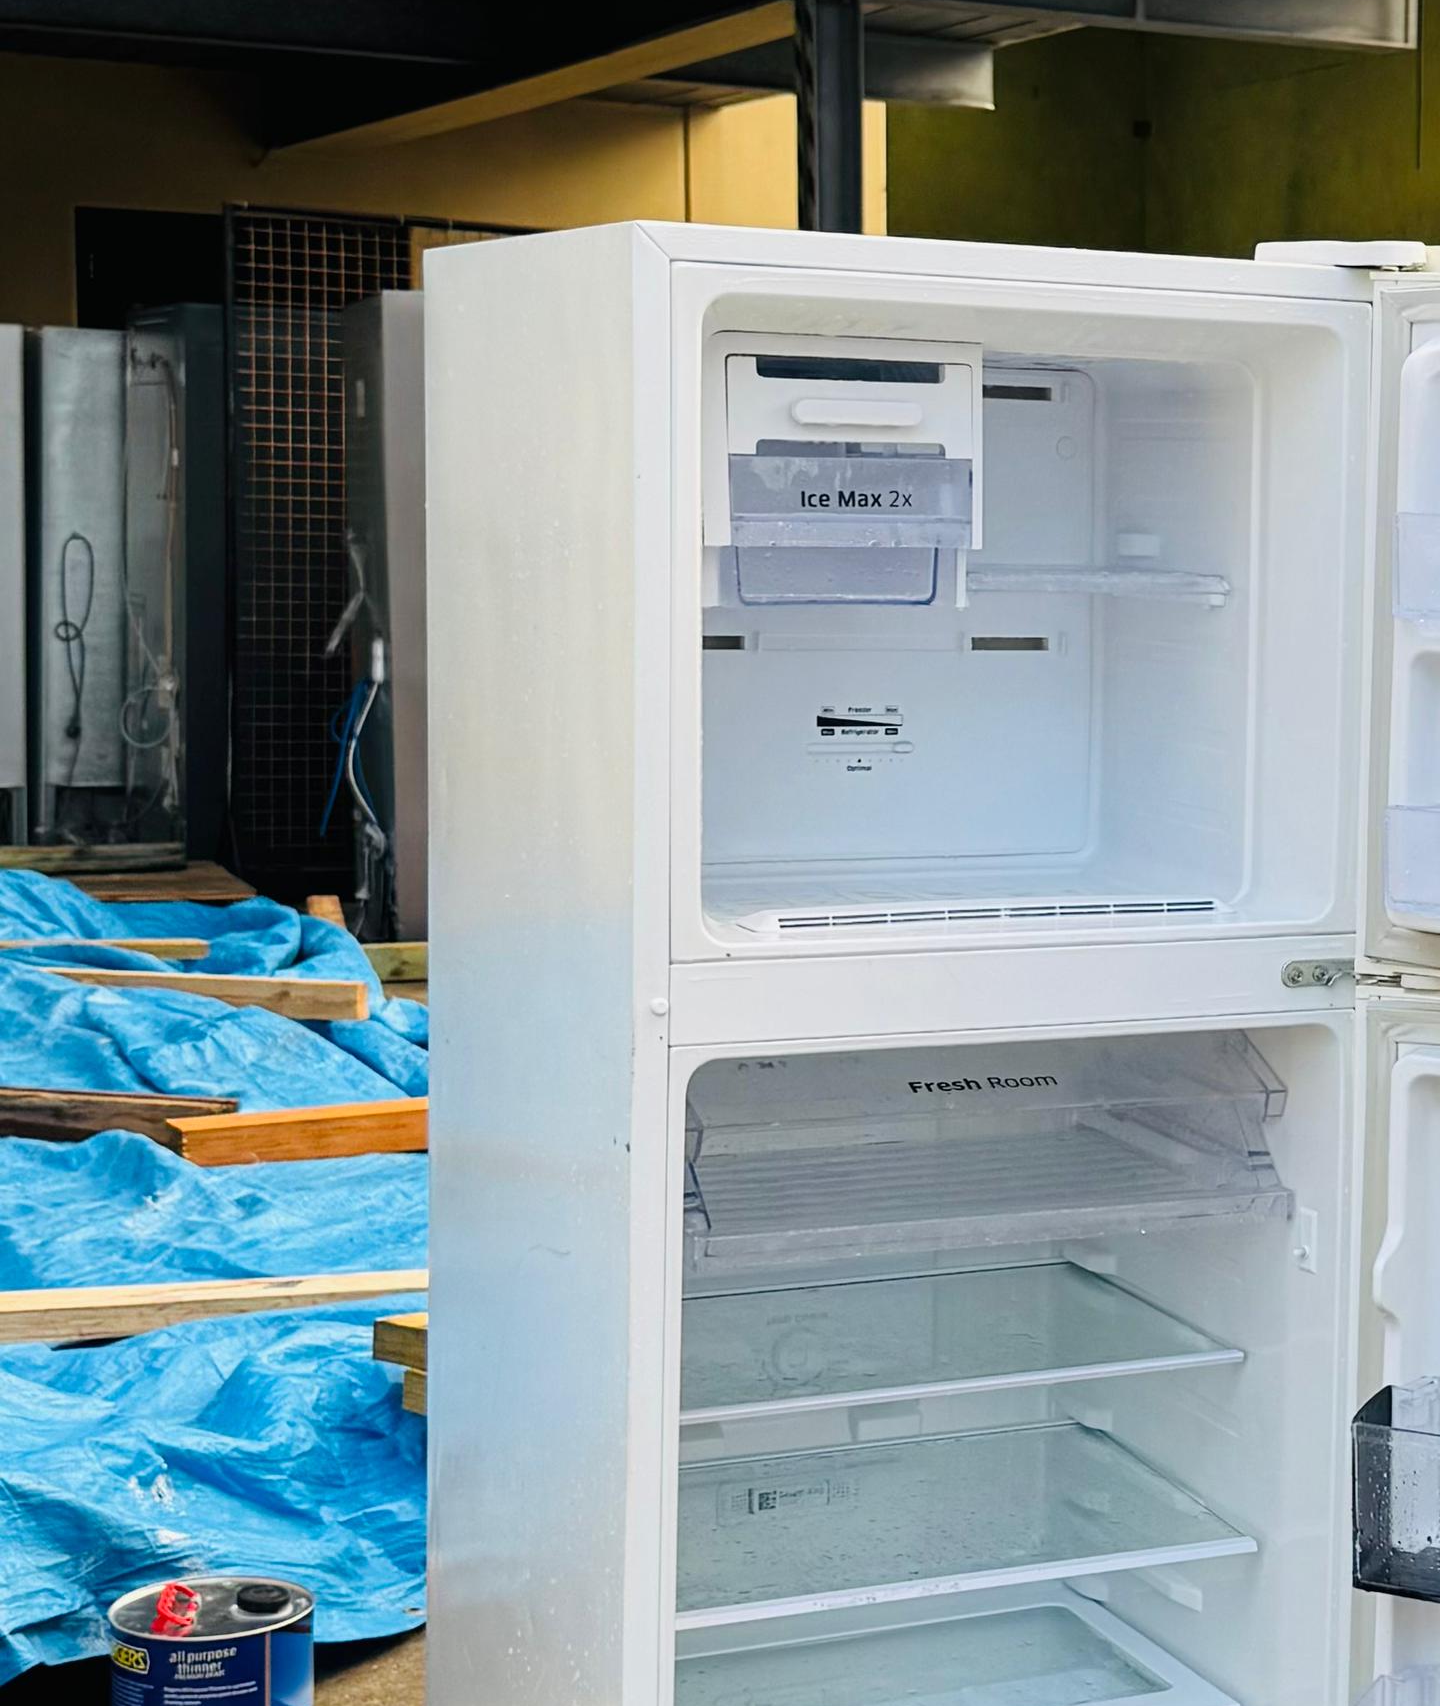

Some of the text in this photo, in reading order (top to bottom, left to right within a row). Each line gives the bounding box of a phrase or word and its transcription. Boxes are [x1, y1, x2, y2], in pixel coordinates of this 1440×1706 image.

[801, 490, 912, 507] Ice Max 2x
[908, 1075, 1058, 1093] Fresh Room
[169, 1647, 237, 1663] all purpose
[177, 1662, 222, 1674] thinner
